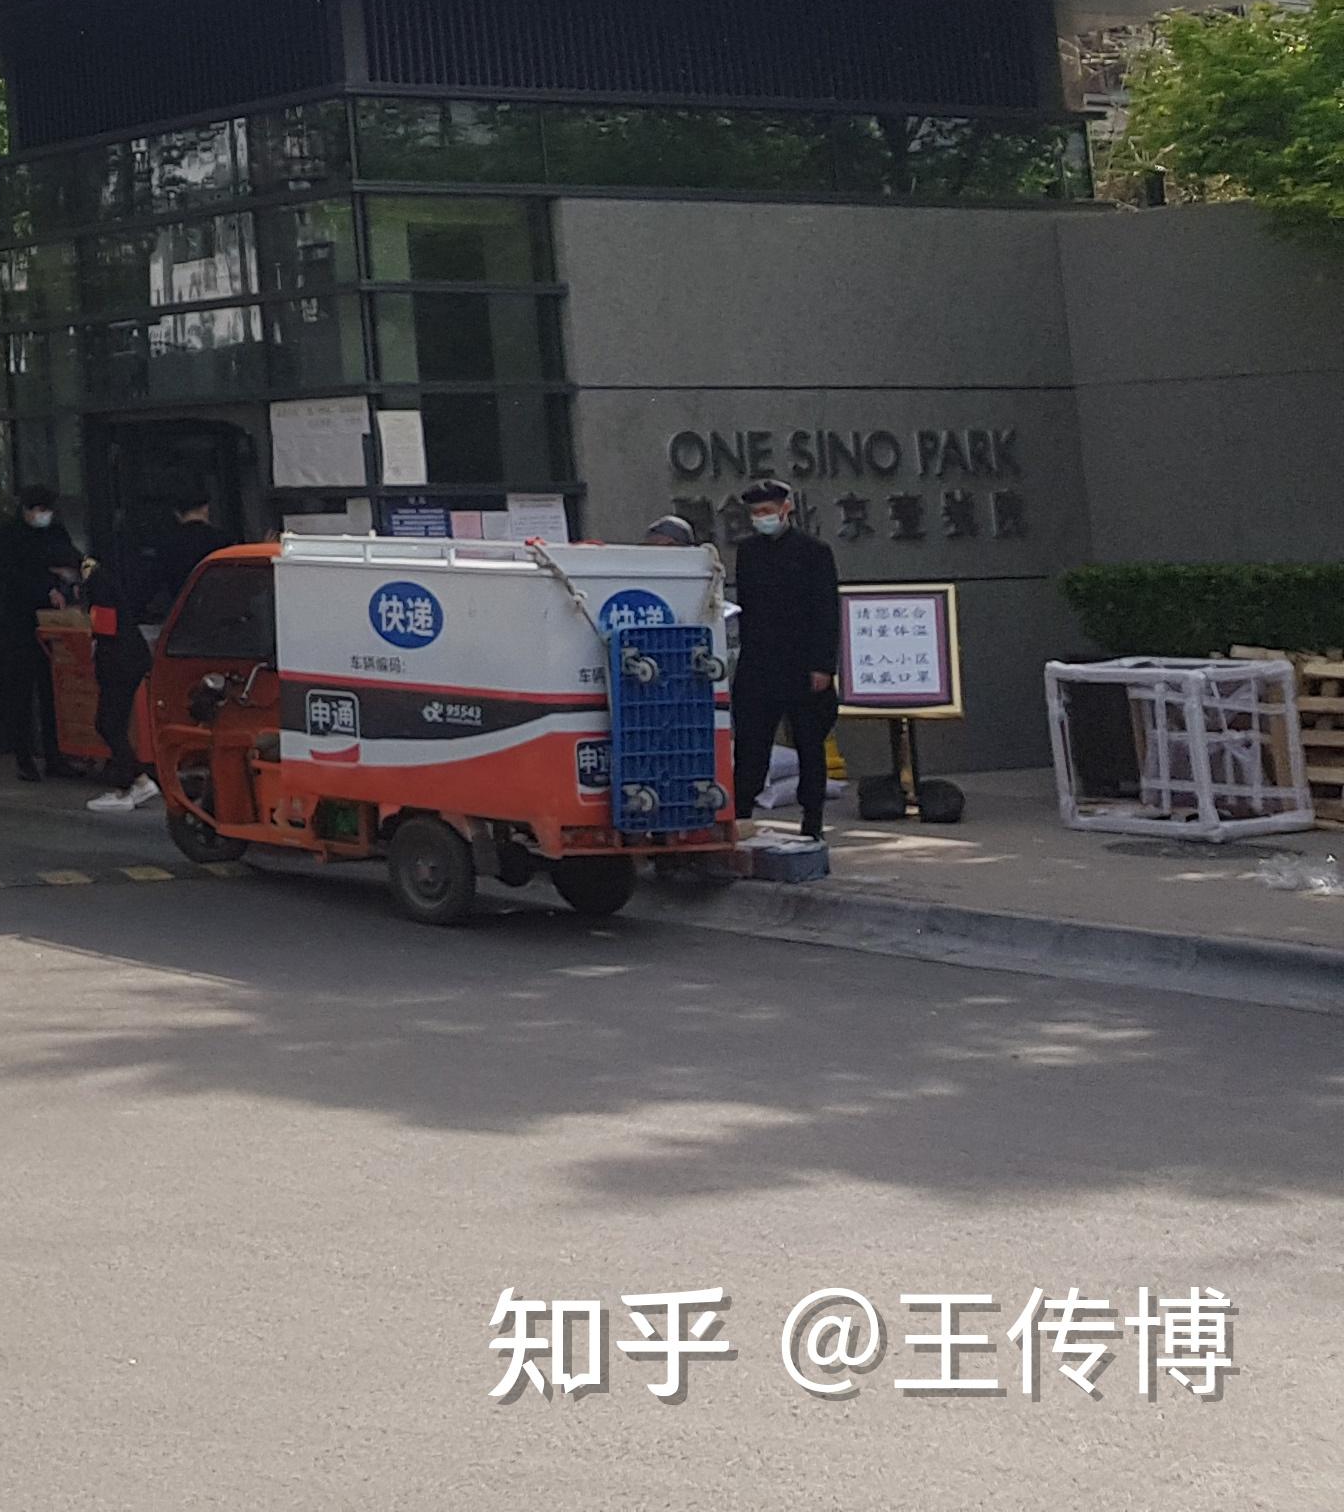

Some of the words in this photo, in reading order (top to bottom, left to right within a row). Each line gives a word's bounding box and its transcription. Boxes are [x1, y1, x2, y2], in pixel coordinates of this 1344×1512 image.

[669, 430, 775, 479] ONE
[788, 430, 902, 478] SINO
[914, 429, 1022, 476] PARK
[377, 593, 436, 637] 快递
[859, 652, 929, 666] 进入小区
[310, 697, 356, 735] 申通
[446, 704, 482, 720] 95543
